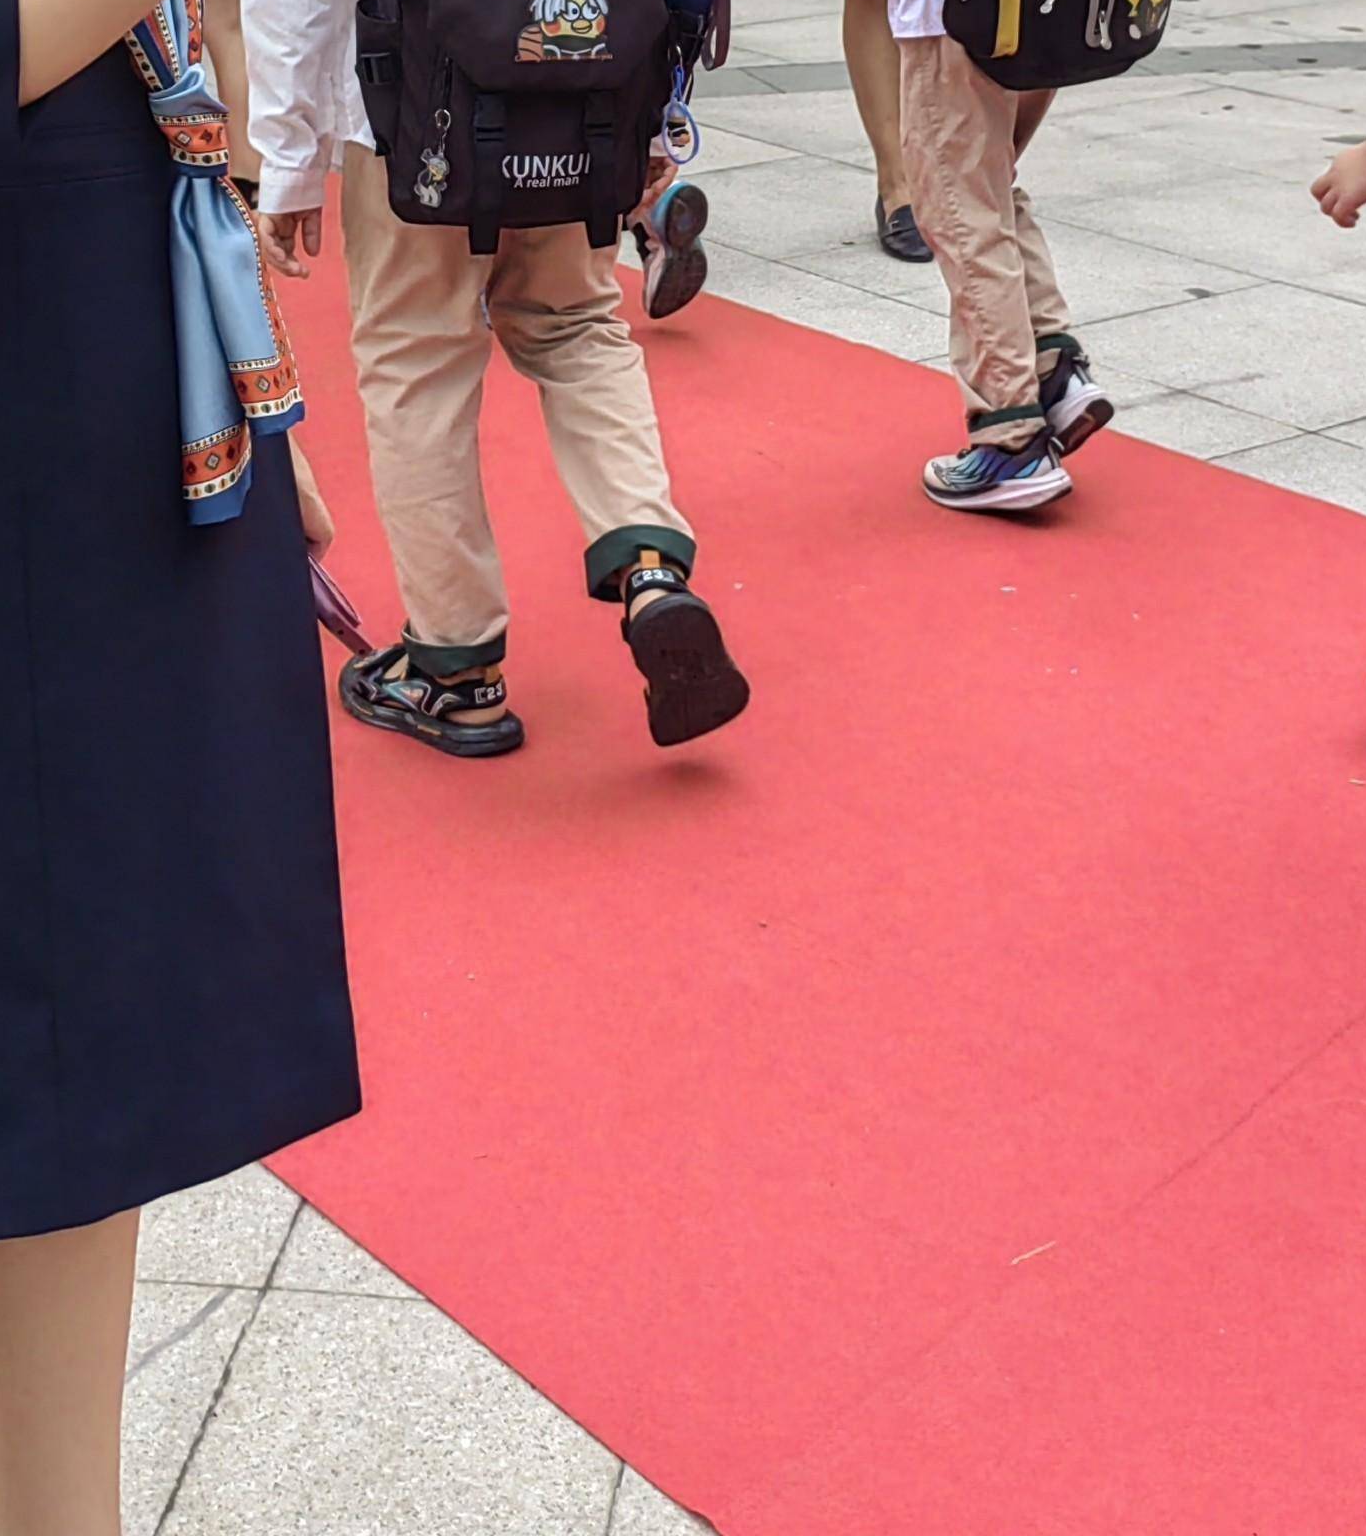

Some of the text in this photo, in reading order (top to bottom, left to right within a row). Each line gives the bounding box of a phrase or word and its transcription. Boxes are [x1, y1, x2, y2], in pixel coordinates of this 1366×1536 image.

[513, 175, 580, 188] A real man
